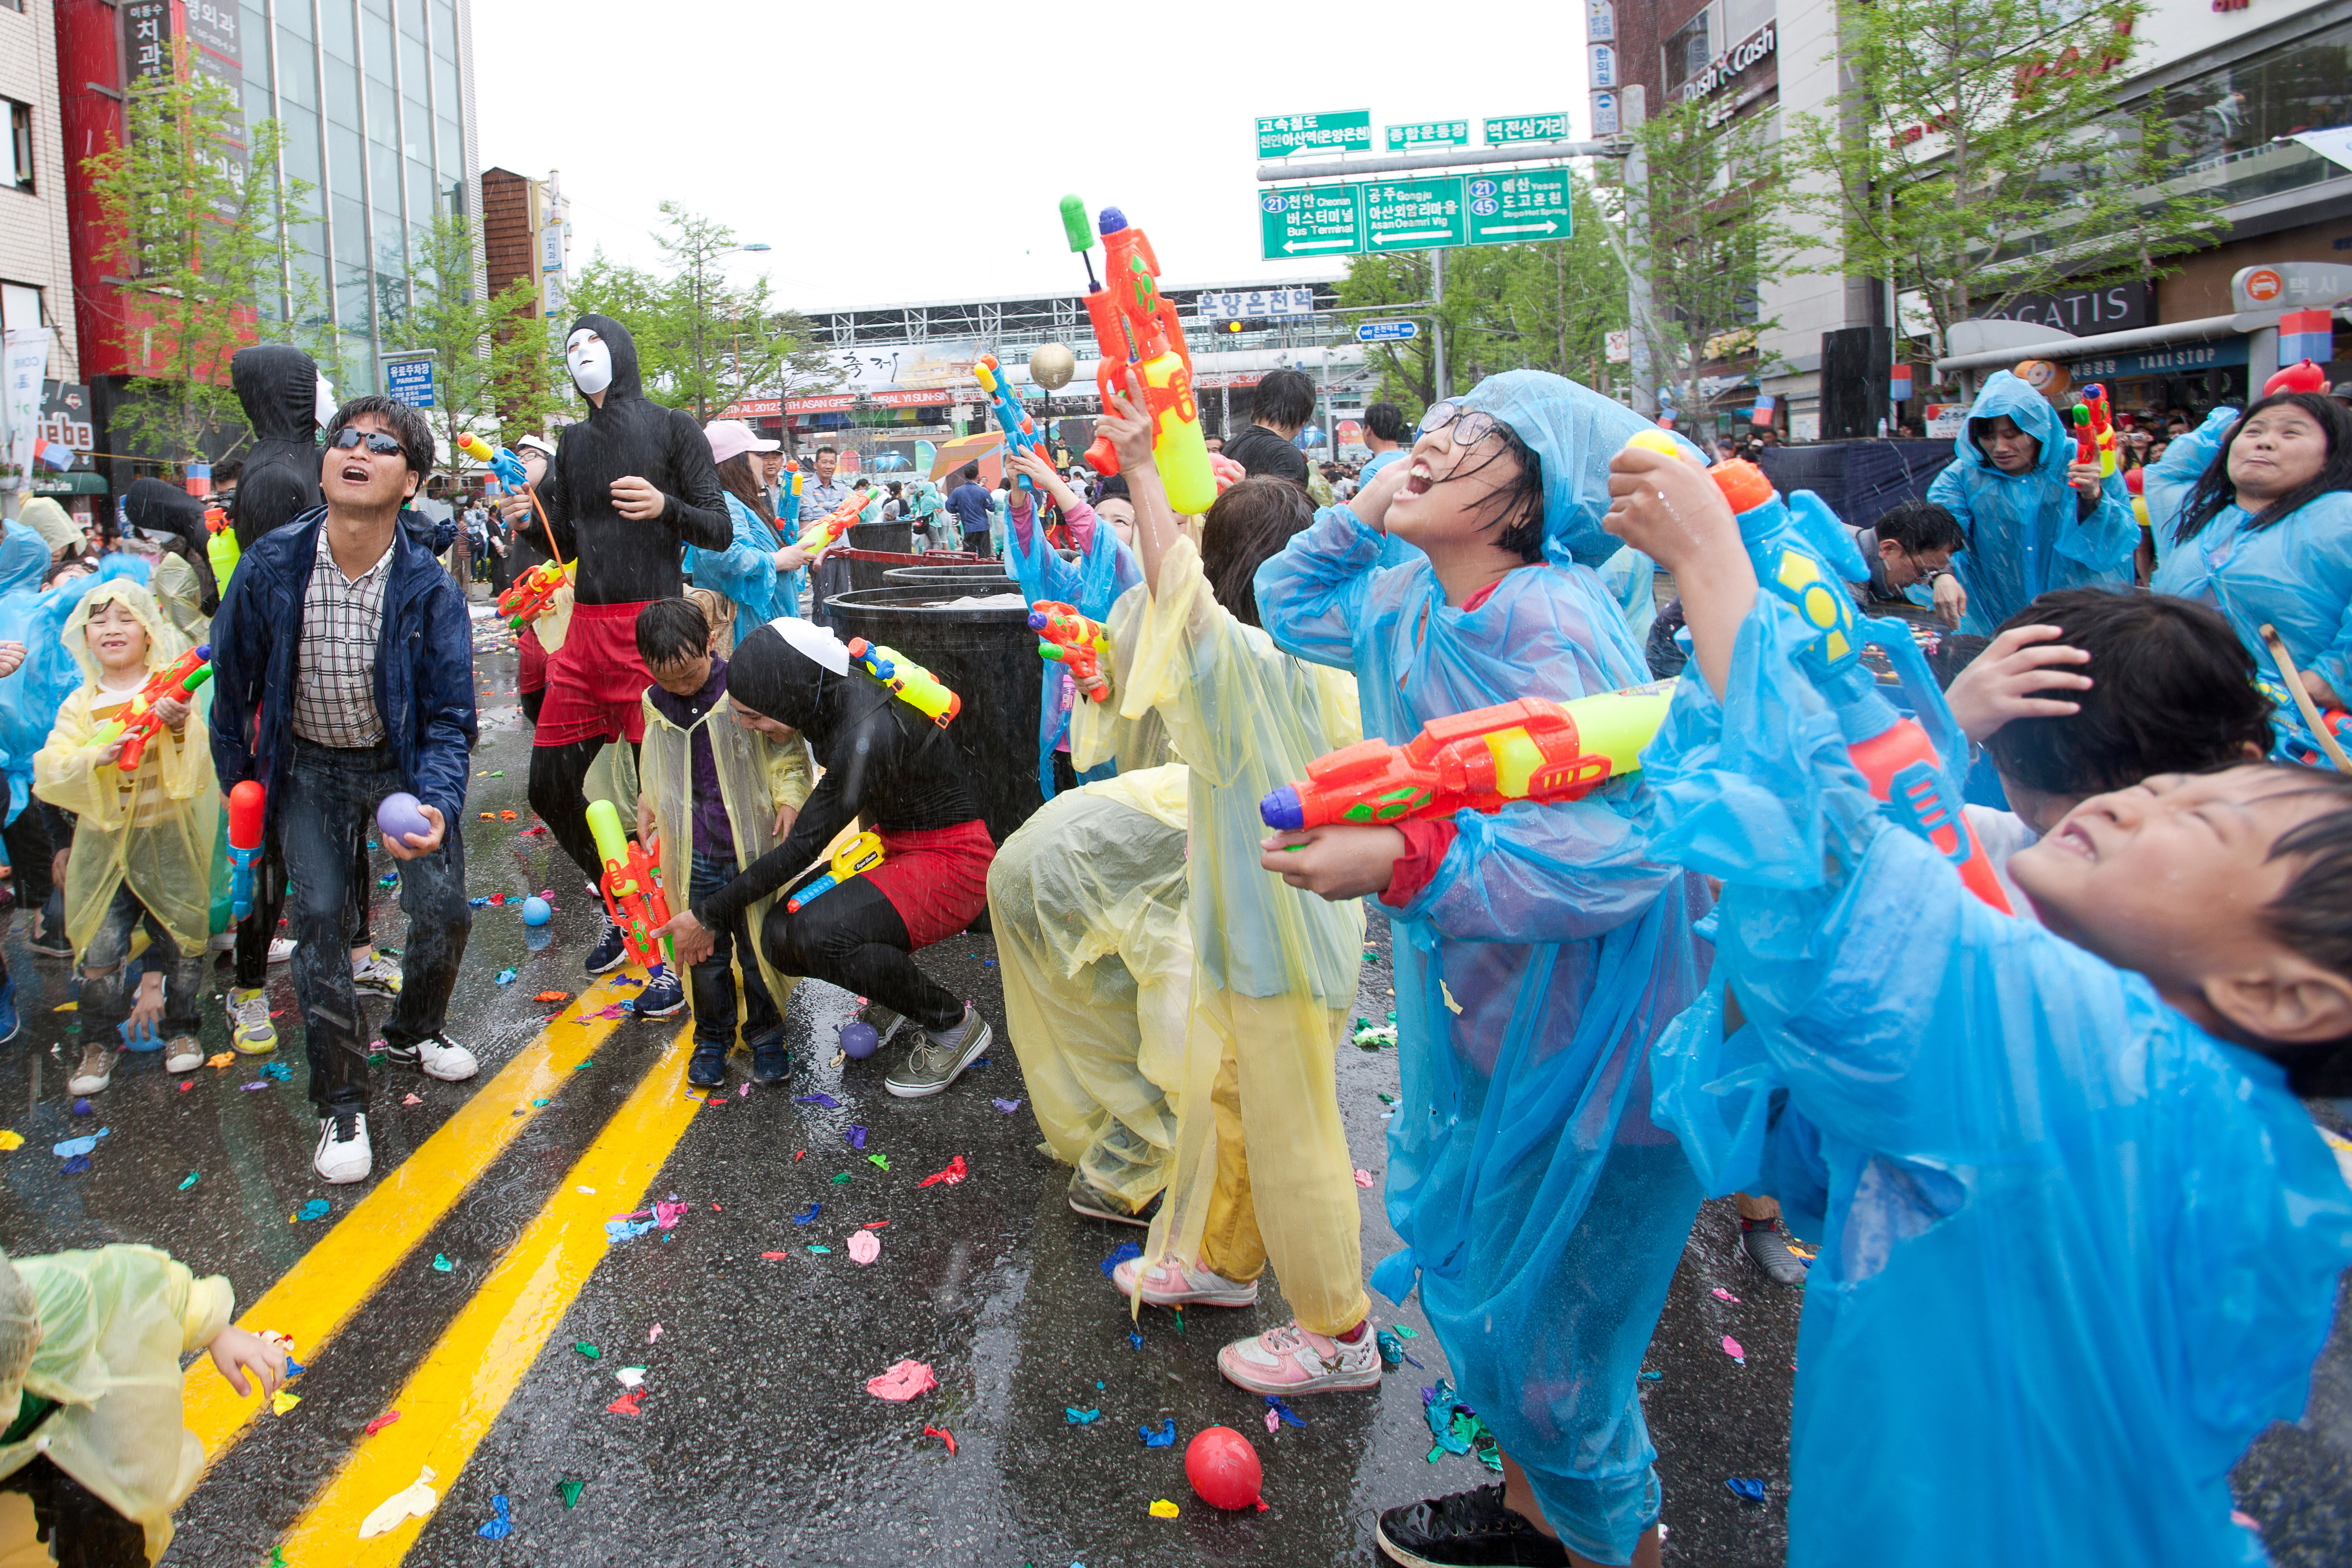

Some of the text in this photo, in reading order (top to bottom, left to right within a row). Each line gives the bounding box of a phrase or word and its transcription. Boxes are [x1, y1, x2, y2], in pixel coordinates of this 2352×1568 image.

[136, 19, 163, 65] 치과
[1734, 27, 1774, 72] Cash
[1595, 48, 1610, 85] 한의원
[1259, 116, 1319, 132] 고속철도
[1390, 123, 1466, 142] 종합운동장
[1487, 114, 1567, 140] 역전삼거리
[1260, 126, 1370, 148] 천안아산역(온양온천)
[1475, 182, 1489, 195] 21
[1502, 177, 1530, 193] 예산
[1288, 194, 1351, 209] 천안 Cheonan
[1369, 187, 1432, 203] 공주 Gongju
[1503, 192, 1562, 208] 도고온천
[1268, 198, 1282, 211] 21
[1369, 200, 1459, 220] 아산외암리마을
[1476, 201, 1493, 213] 45
[1286, 208, 1354, 226] 버스터미널
[1287, 223, 1354, 237] Bus Terminal
[2290, 276, 2339, 296] 택시
[1200, 290, 1313, 317] 온양온천역
[1988, 287, 2129, 328] GATIS
[2139, 353, 2173, 369] TAXI
[2176, 348, 2215, 365] STOP
[390, 363, 429, 378] 유료주차장
[396, 375, 425, 384] PARKING
[754, 402, 776, 412] 2012
[802, 397, 828, 409] ASAN
